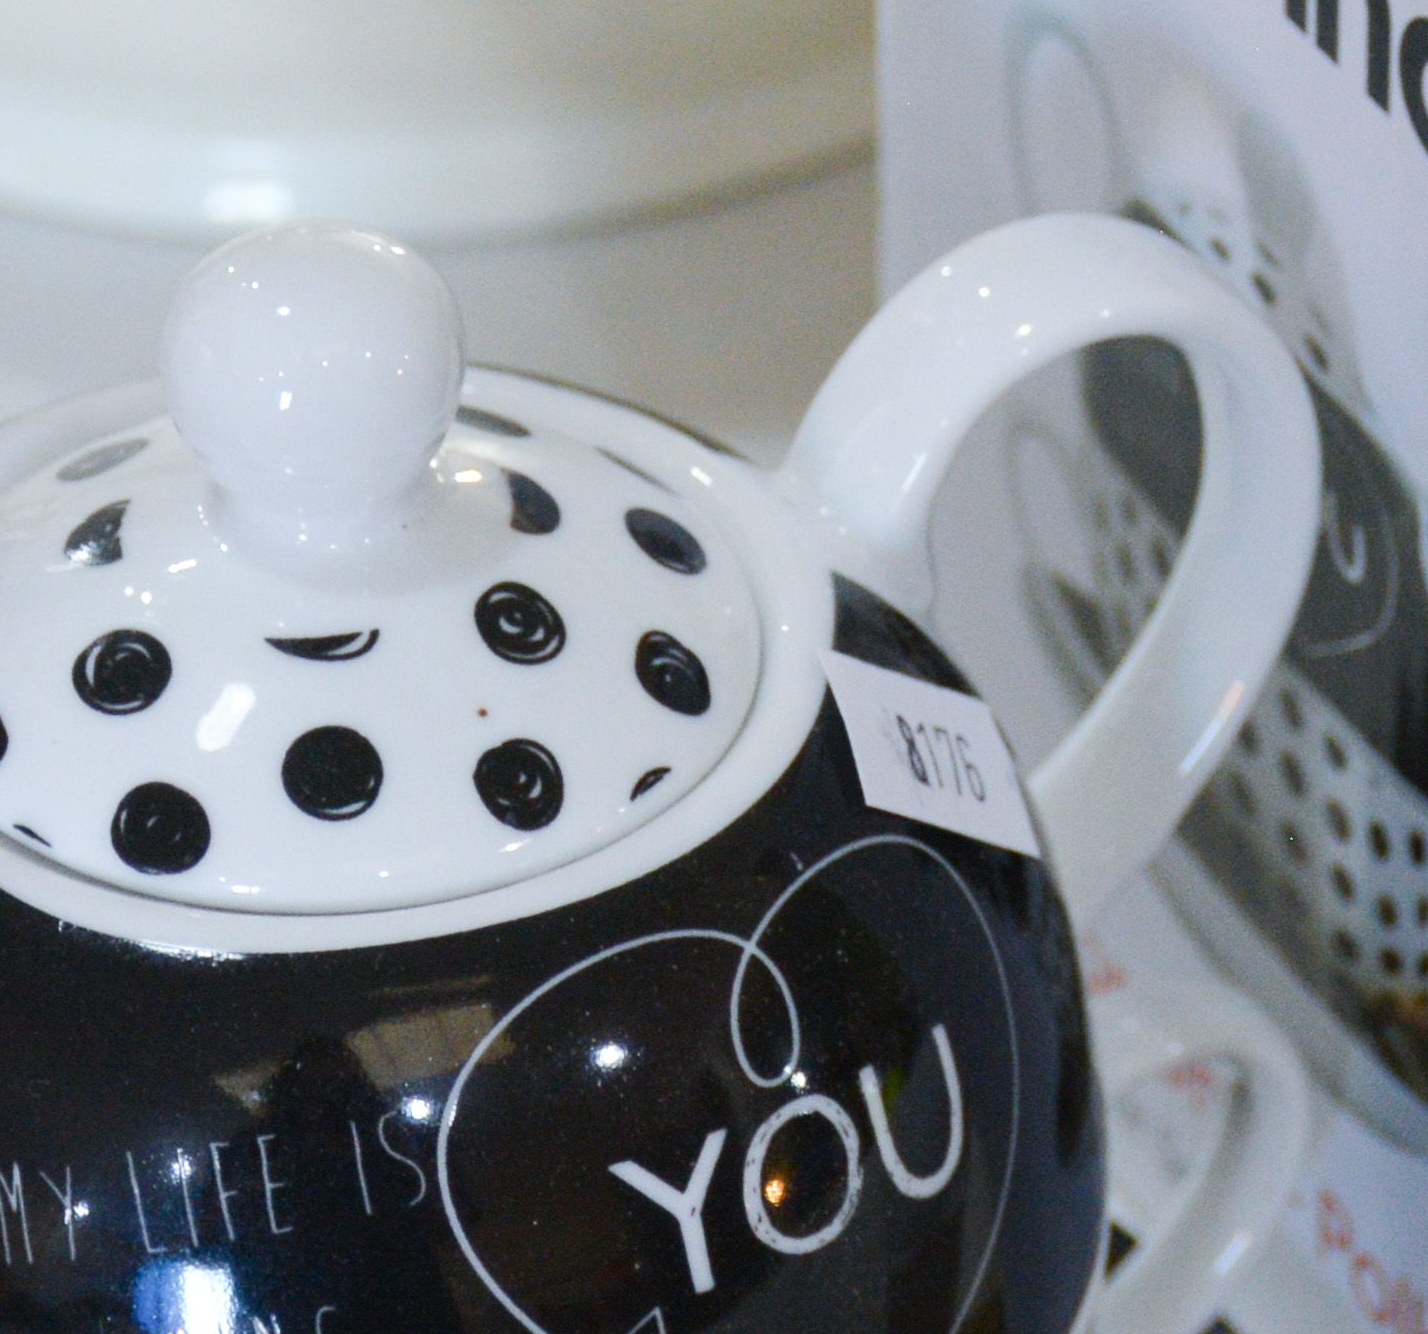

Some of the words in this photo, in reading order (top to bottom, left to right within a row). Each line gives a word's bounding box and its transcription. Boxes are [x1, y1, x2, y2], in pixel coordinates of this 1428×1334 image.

[896, 714, 986, 802] 8176
[125, 1130, 292, 1256] LIFE
[352, 1109, 429, 1217] IS
[608, 1024, 965, 1295] YOU
